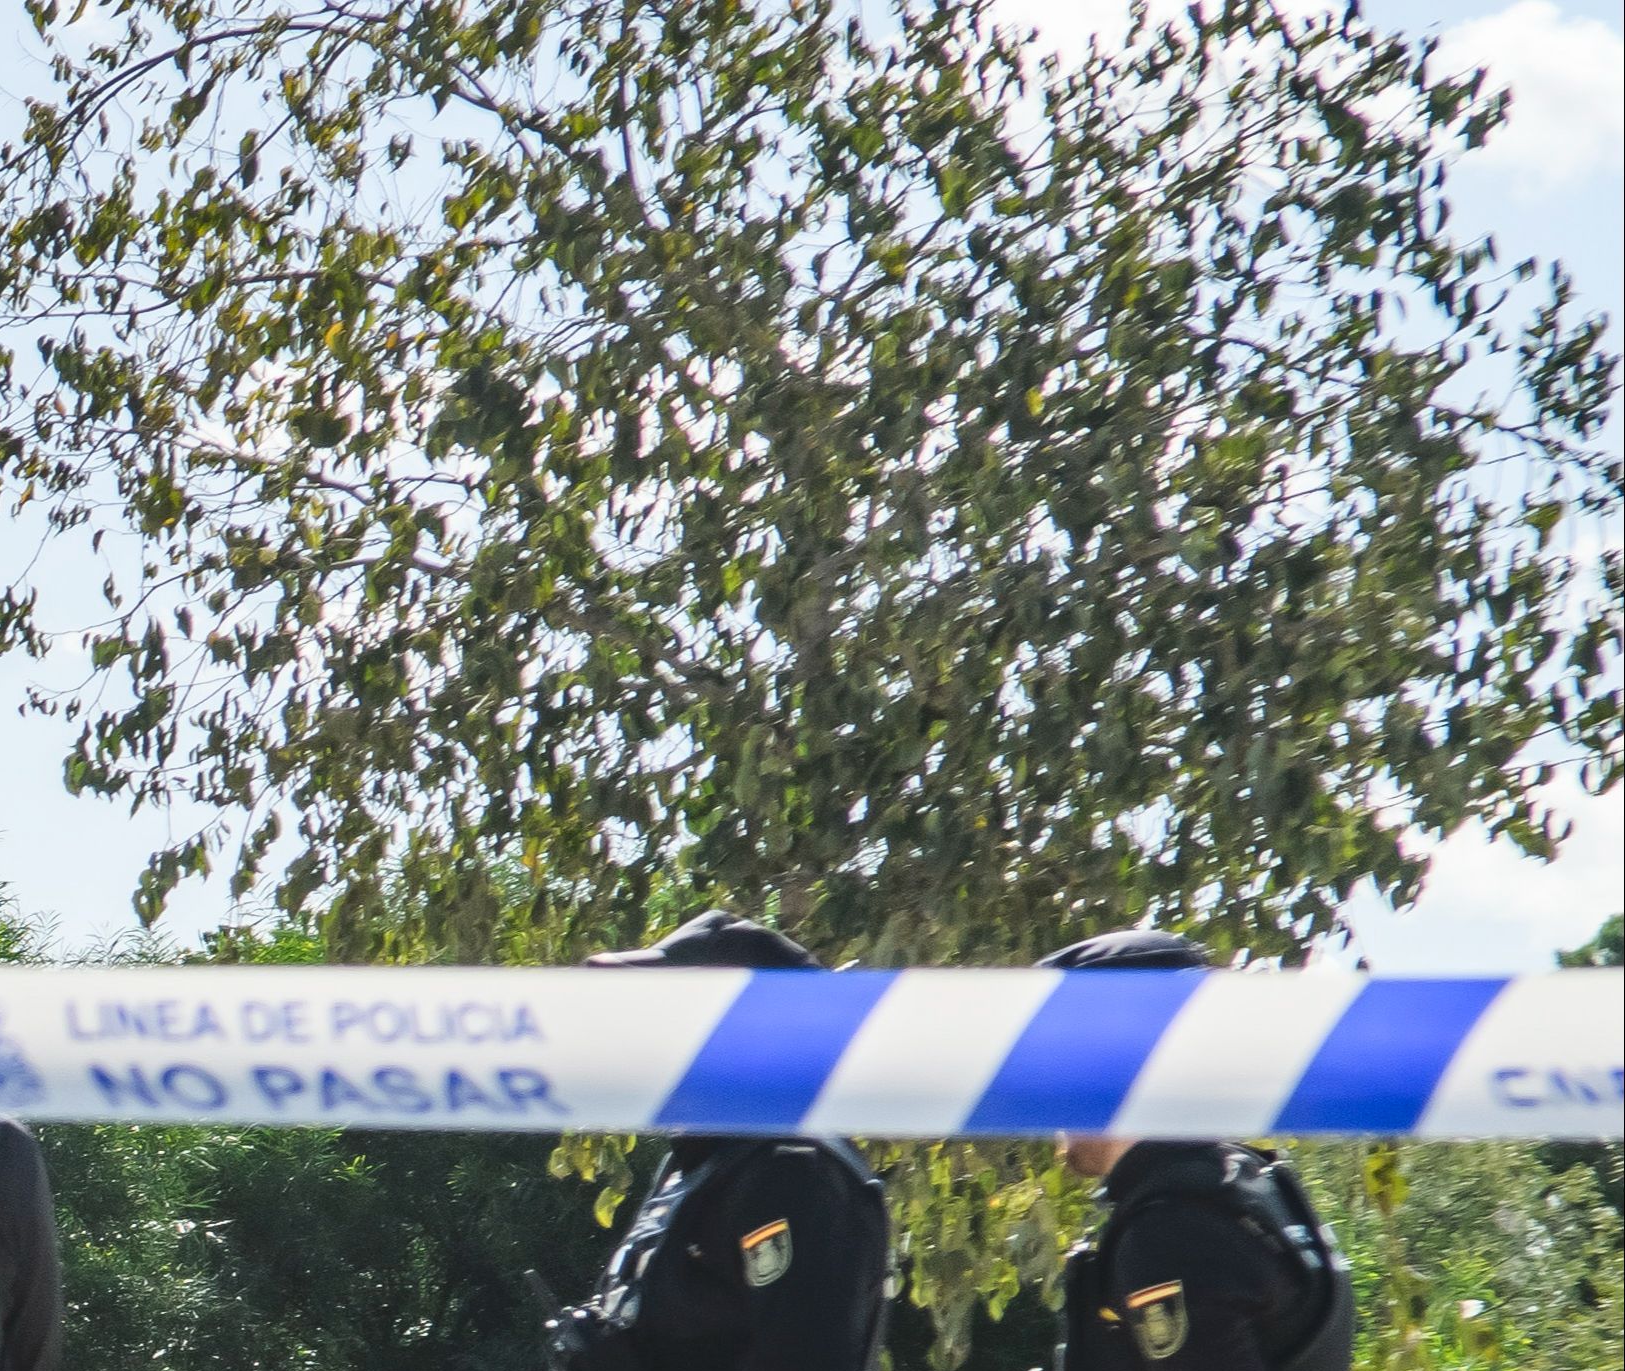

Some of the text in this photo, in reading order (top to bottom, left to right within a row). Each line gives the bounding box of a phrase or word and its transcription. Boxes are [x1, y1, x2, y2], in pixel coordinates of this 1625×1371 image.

[65, 1000, 547, 1043] LINEA DE POLICIA
[88, 1063, 573, 1114] NO PASAR
[1493, 1067, 1624, 1108] CN
